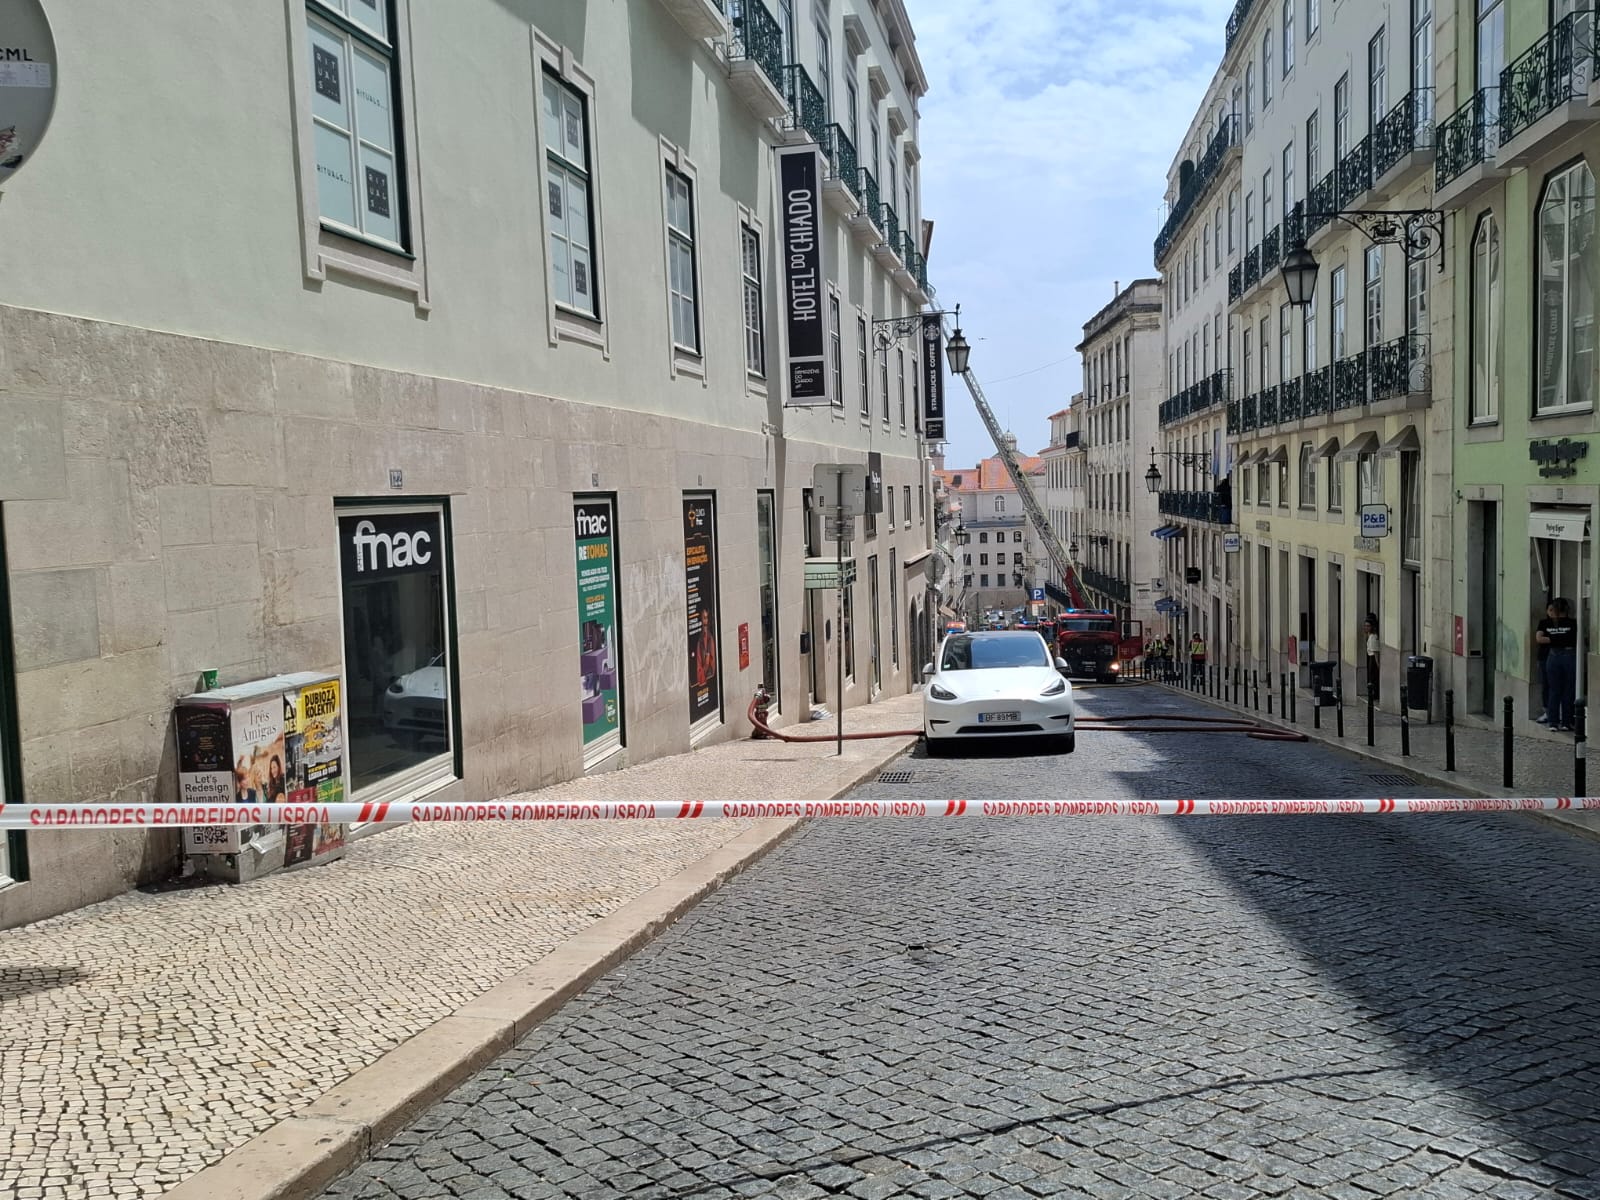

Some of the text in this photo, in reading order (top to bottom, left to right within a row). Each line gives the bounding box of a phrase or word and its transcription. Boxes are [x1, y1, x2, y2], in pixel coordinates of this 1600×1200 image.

[788, 189, 817, 321] HOTEL DO CHIADO
[930, 369, 938, 412] STARBUCKS
[577, 508, 607, 536] fnac
[1363, 513, 1386, 524] P&B
[353, 520, 432, 572] fnac
[578, 544, 609, 560] RETOMAS
[248, 709, 270, 726] Três
[241, 724, 277, 743] Amigas
[195, 774, 218, 784] Let's
[185, 783, 229, 793] Redesign
[186, 793, 230, 804] Humanity
[30, 808, 146, 825] SAPADORES
[152, 807, 261, 824] BOMBEIROS
[411, 805, 507, 821] SAPADORES
[511, 804, 600, 820] BOMBEIROS
